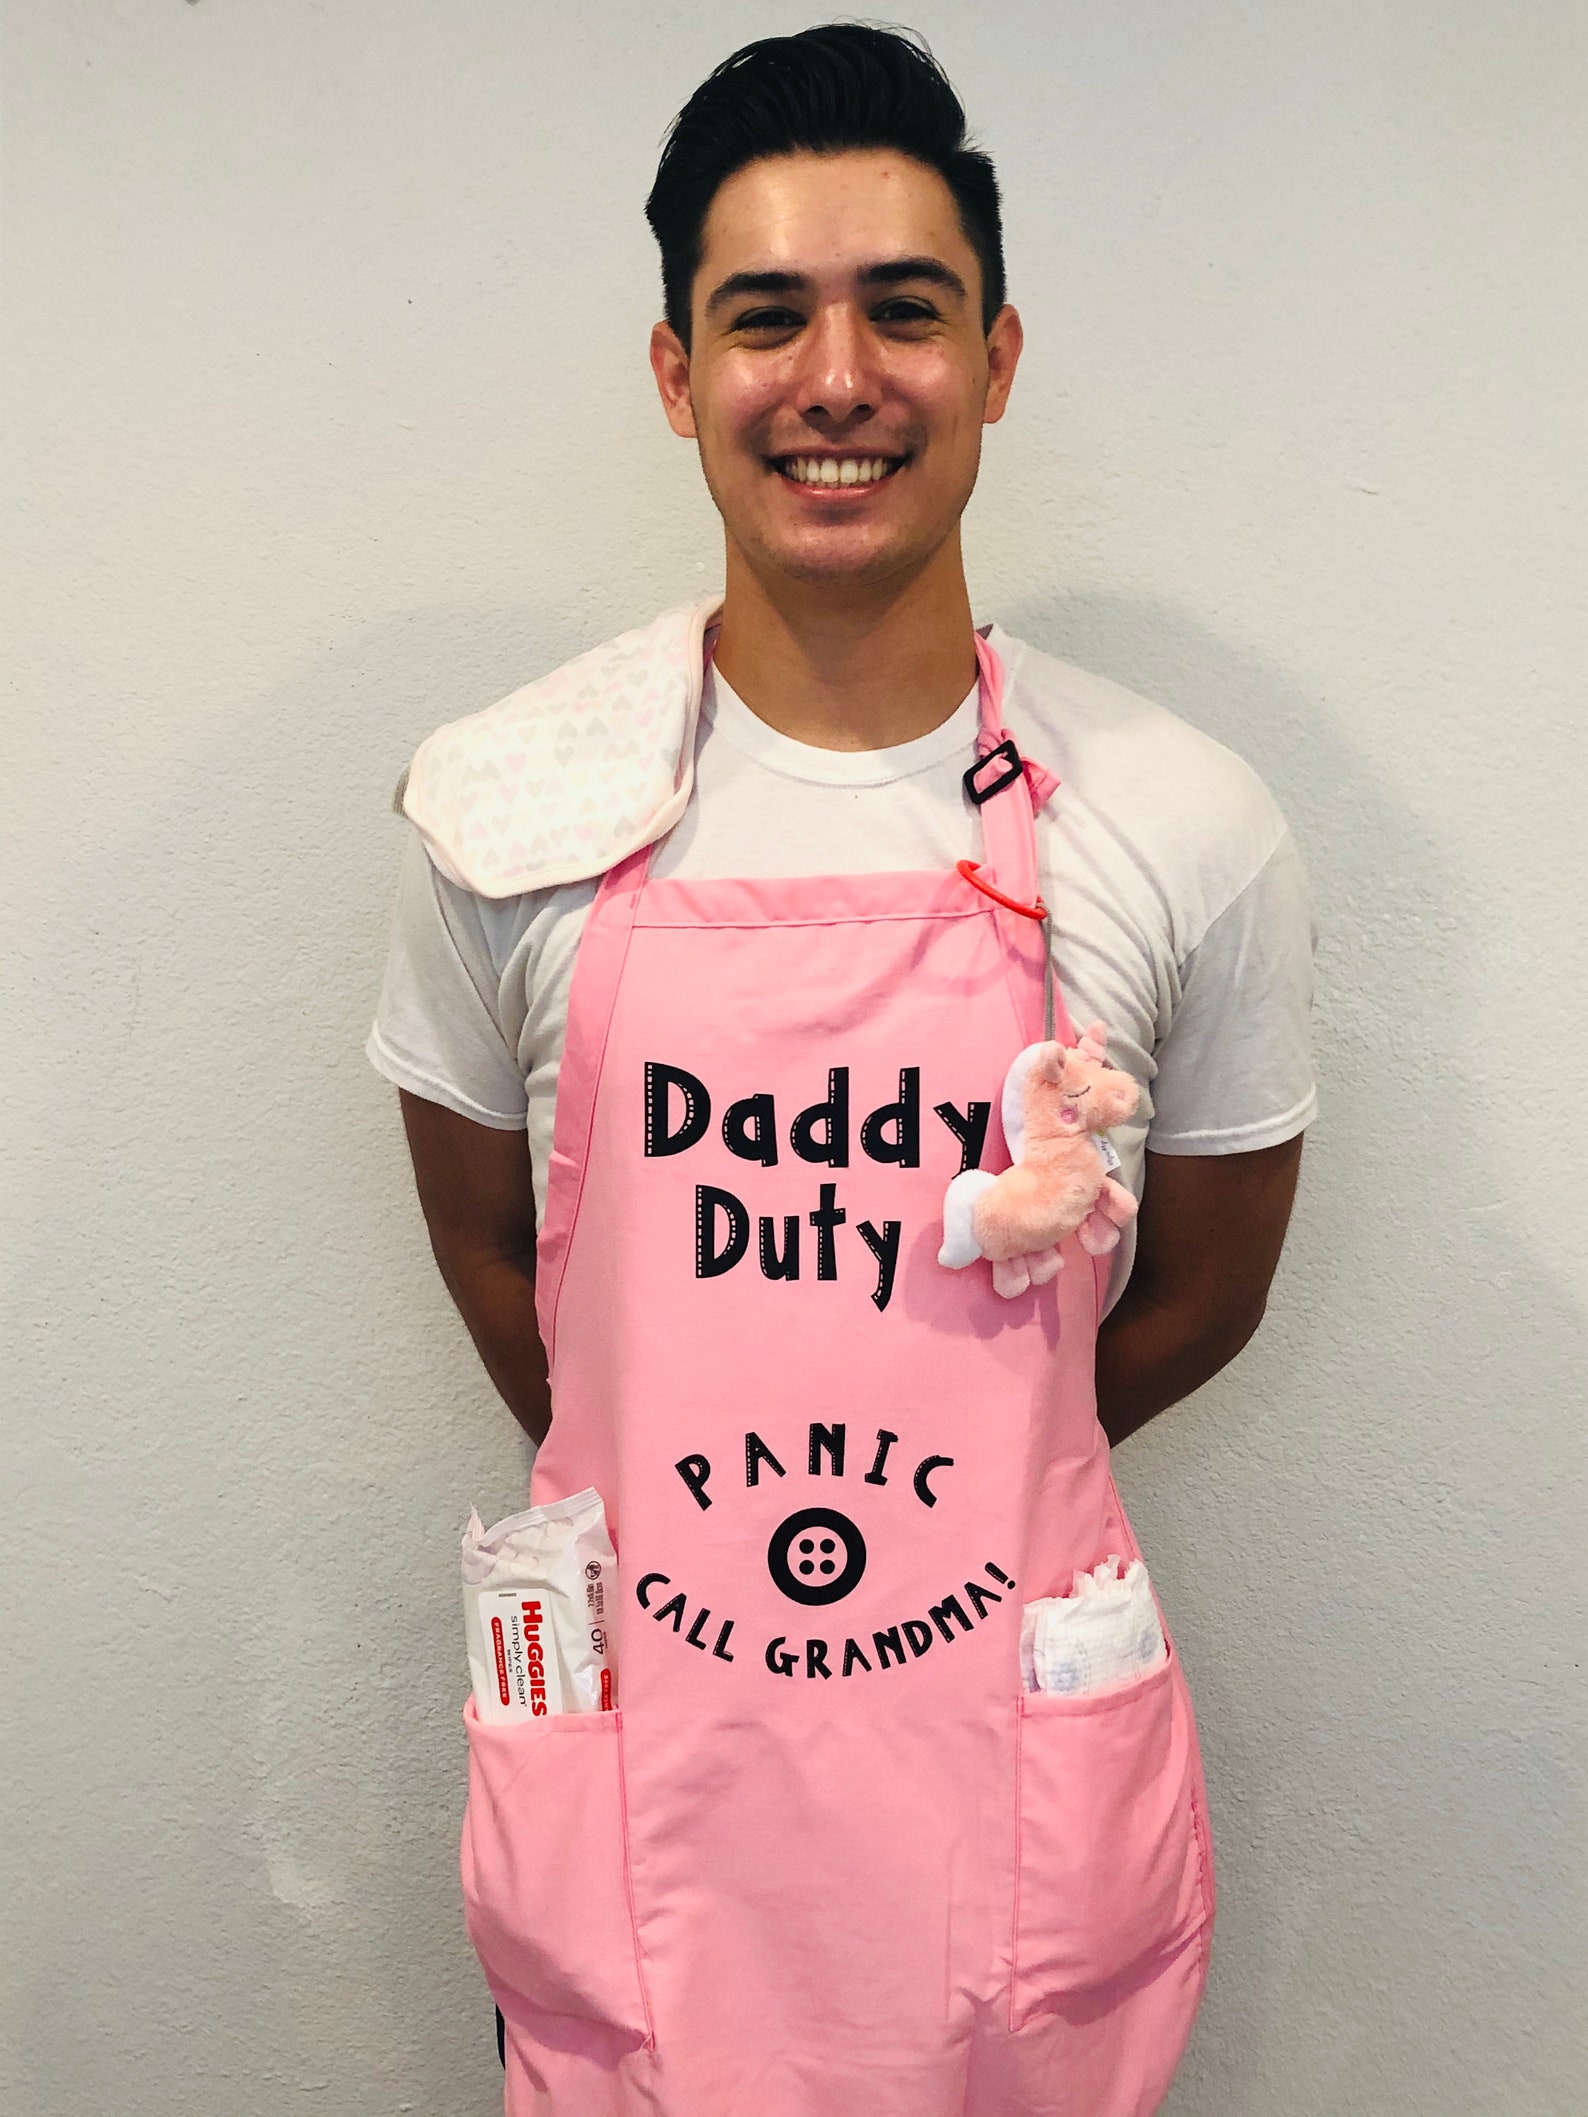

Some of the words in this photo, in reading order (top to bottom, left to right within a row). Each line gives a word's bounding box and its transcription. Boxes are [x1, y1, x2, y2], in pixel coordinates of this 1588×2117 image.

[645, 1062, 990, 1179] Daddy
[696, 1183, 901, 1312] Duty
[675, 1423, 954, 1511] PANIC
[494, 1622, 504, 1675] FRAGRANCE
[510, 1615, 523, 1663] simply
[591, 1628, 604, 1655] 40
[637, 1573, 734, 1662] CALL
[766, 1562, 1015, 1679] GRANDMA!
